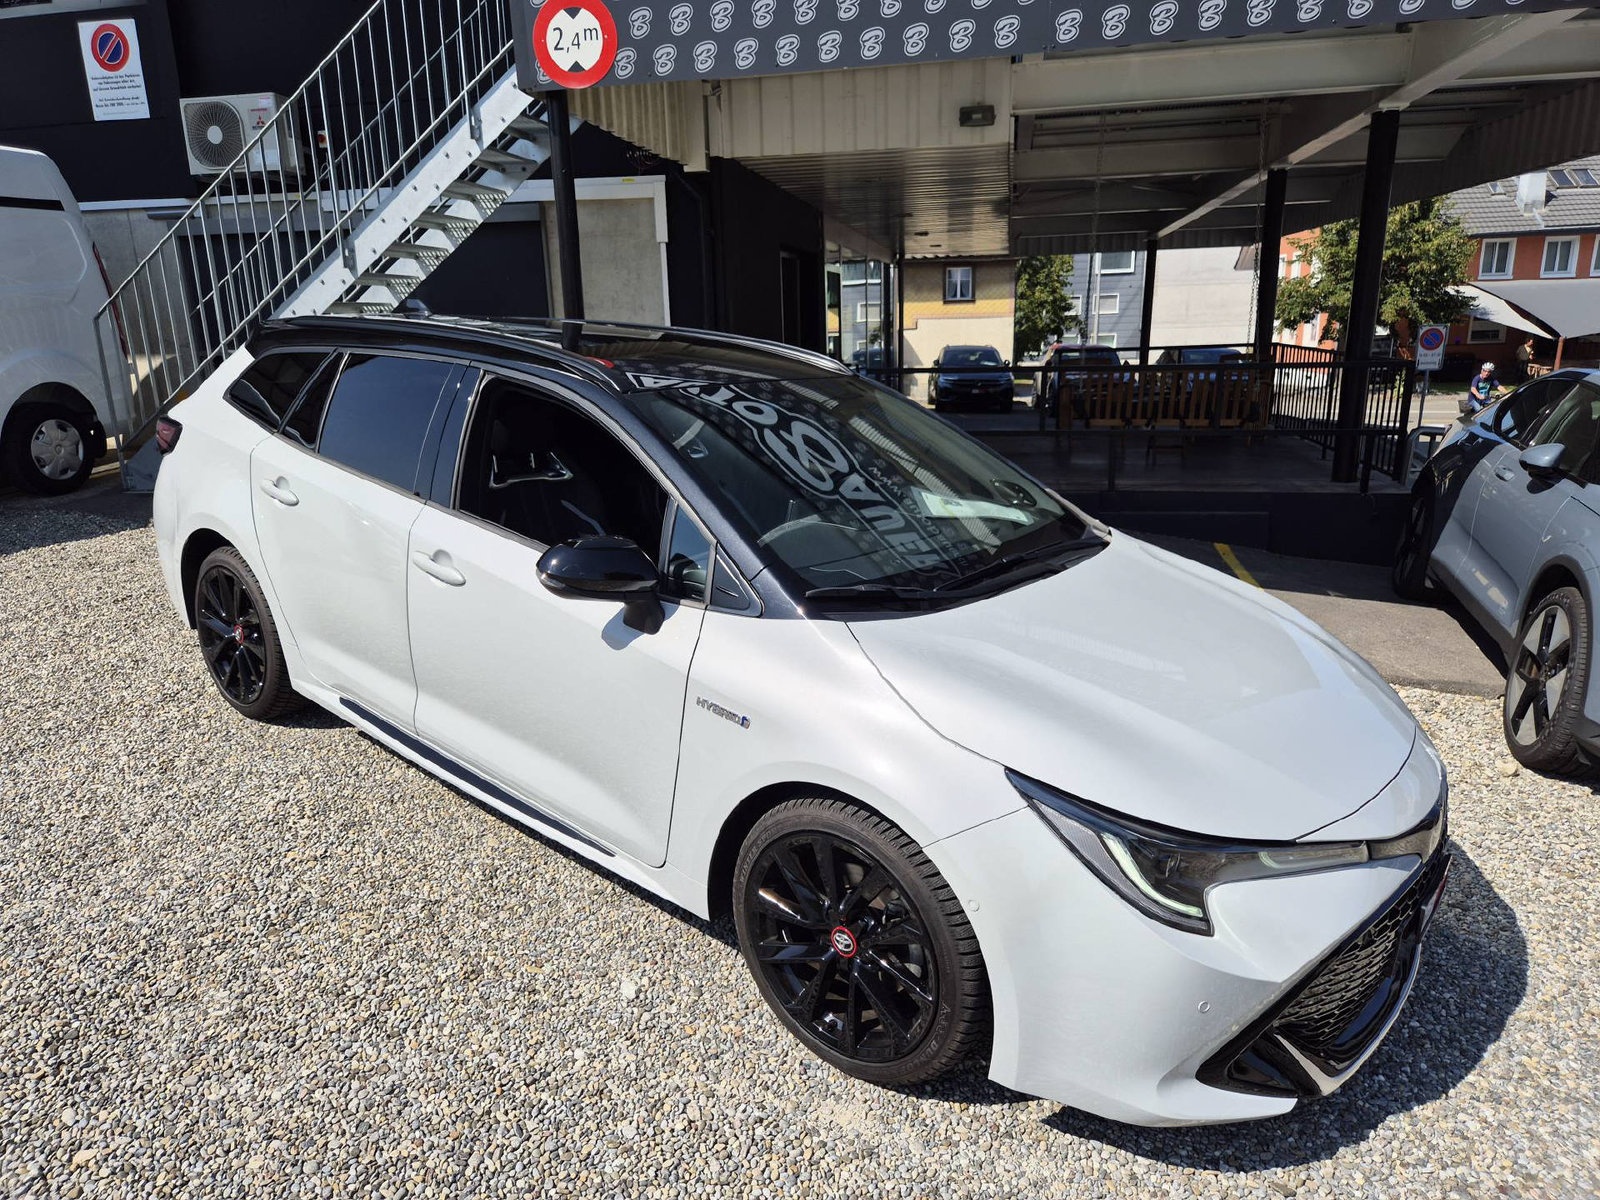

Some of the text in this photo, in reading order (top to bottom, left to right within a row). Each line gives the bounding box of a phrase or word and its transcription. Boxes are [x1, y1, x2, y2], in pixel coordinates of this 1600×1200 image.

[629, 7, 652, 39] B
[669, 3, 693, 36] B
[710, 0, 734, 32] B
[752, 0, 776, 29] B
[614, 47, 637, 79] B
[653, 44, 677, 76] B
[693, 40, 718, 73] B
[734, 37, 758, 70] B
[775, 34, 800, 67] B
[817, 30, 842, 63] B
[860, 26, 885, 59] B
[904, 22, 929, 56] B
[949, 19, 976, 52] B
[994, 15, 1020, 49] B
[1056, 9, 1083, 43] B
[1102, 4, 1130, 40] B
[1149, 0, 1179, 36] B
[1198, 0, 1227, 31] B
[696, 696, 742, 726] HYBRID
